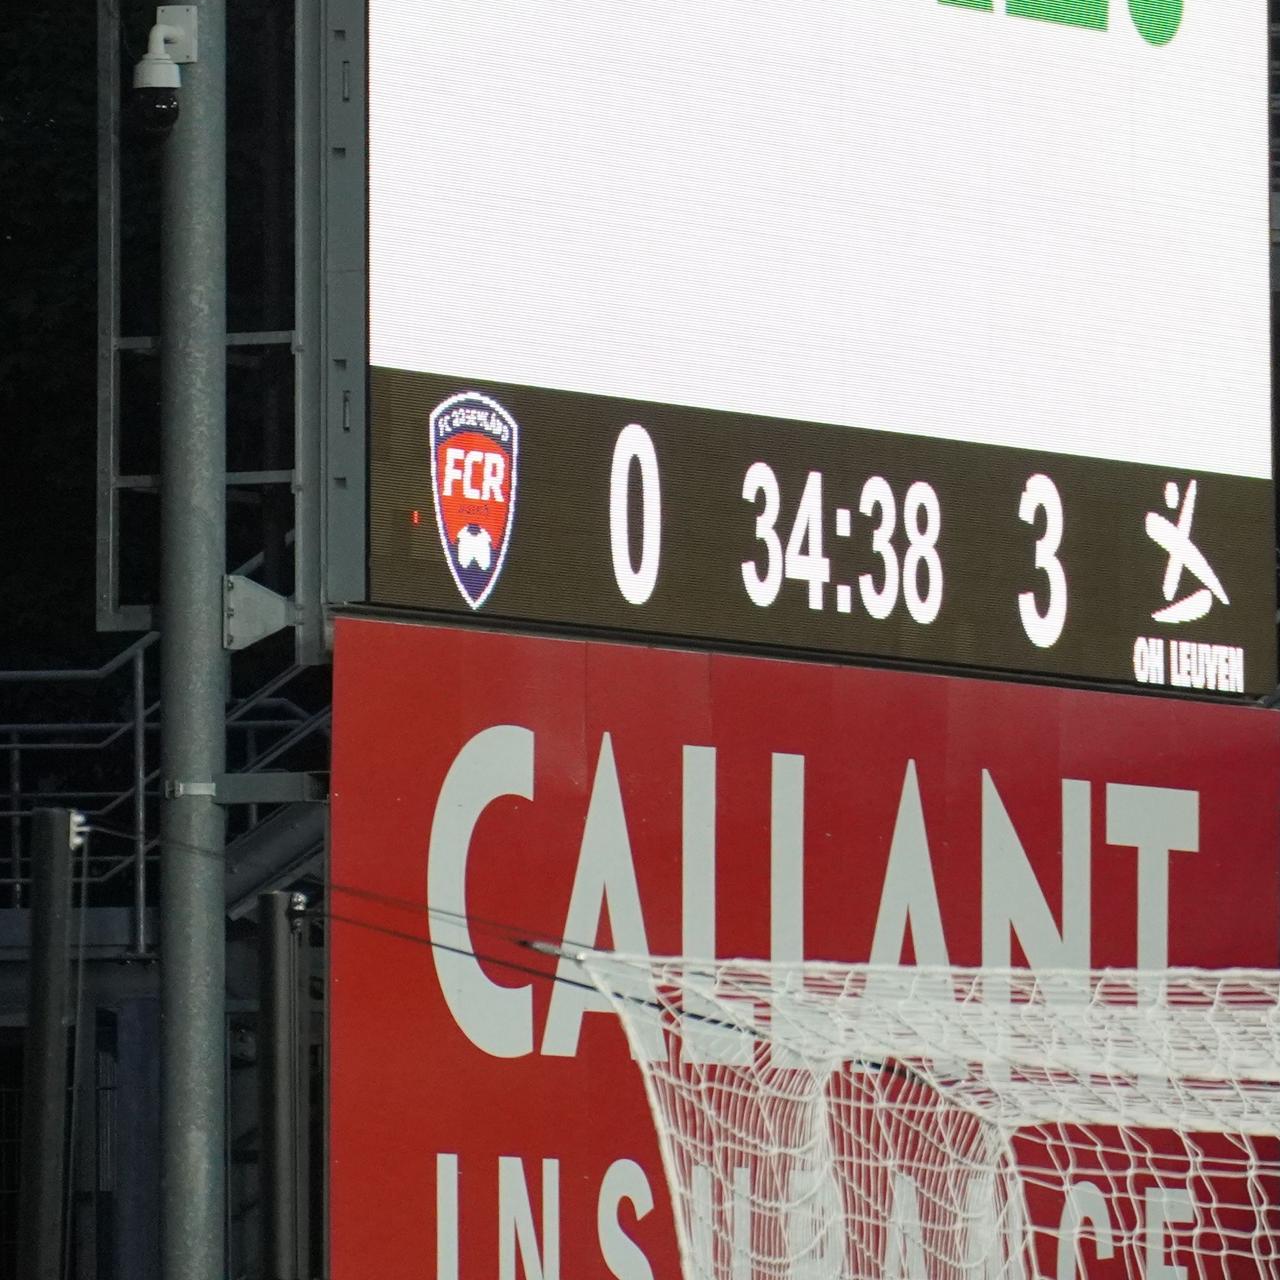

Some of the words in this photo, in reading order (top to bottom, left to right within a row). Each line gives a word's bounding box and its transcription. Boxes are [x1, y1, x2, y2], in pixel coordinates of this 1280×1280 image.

[442, 447, 506, 503] FCR
[610, 423, 662, 606] 0
[740, 461, 943, 625] 34:38
[1017, 473, 1068, 648] 3
[1133, 636, 1166, 685] OH
[1169, 639, 1245, 694] LEUVEN
[426, 724, 1200, 1085] CALLANT
